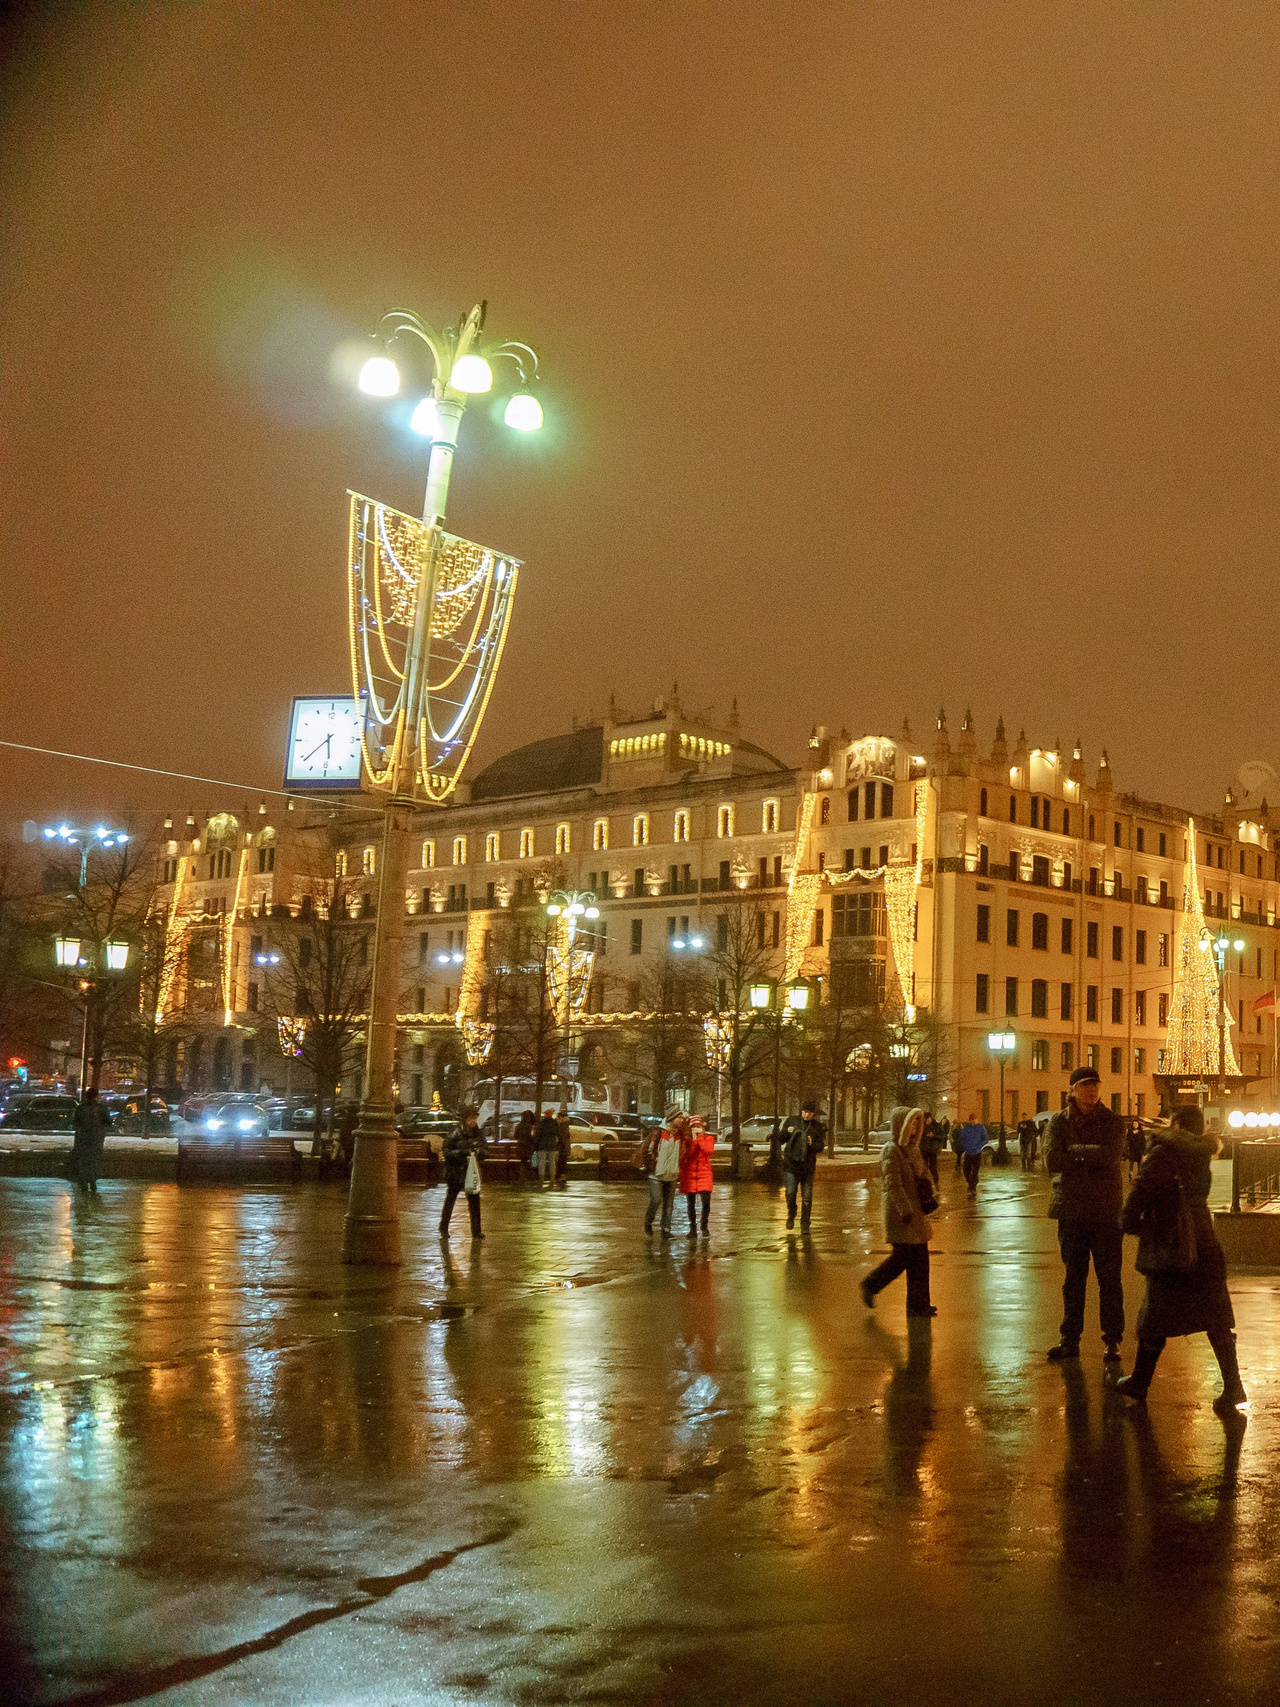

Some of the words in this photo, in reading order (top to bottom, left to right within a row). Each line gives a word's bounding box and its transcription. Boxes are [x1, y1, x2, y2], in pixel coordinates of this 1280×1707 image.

[328, 712, 336, 720] 12
[350, 736, 355, 744] 3
[323, 761, 329, 769] 6
